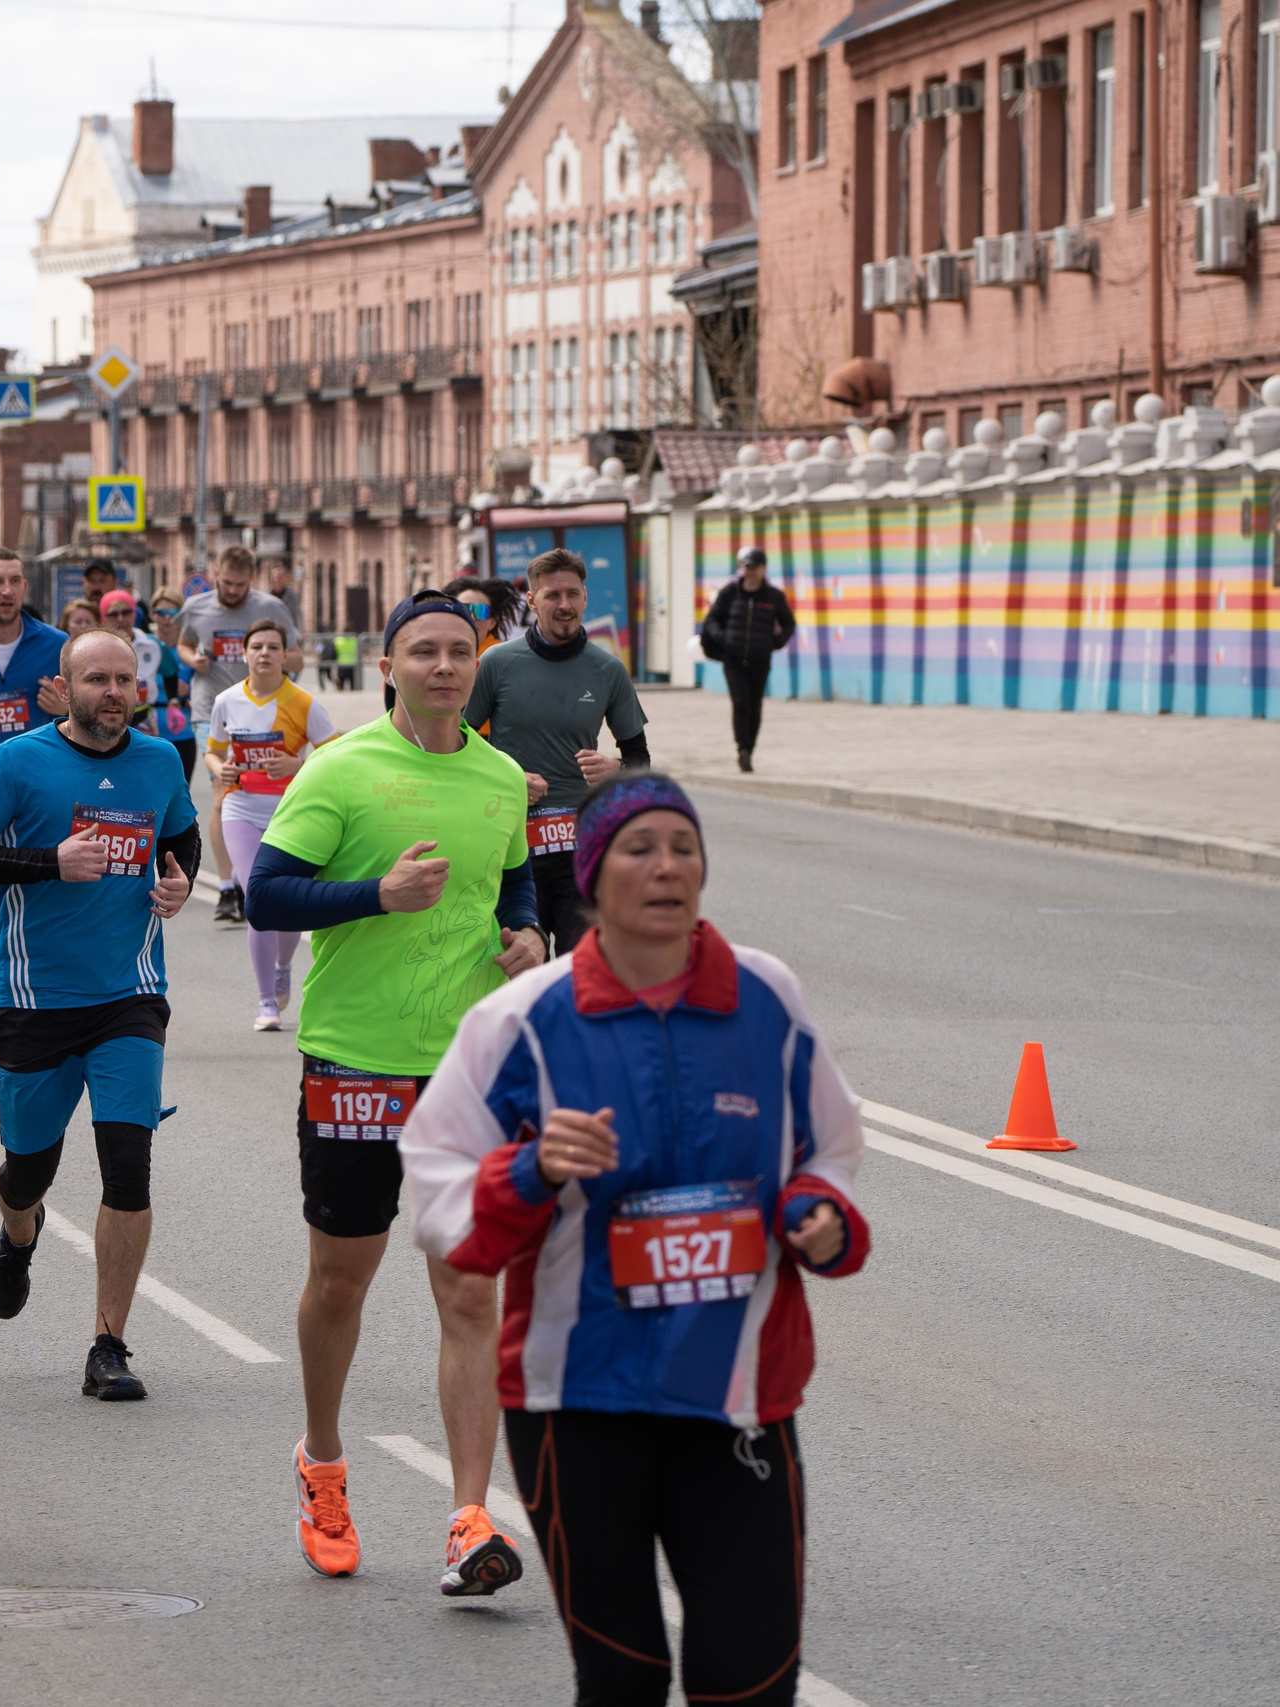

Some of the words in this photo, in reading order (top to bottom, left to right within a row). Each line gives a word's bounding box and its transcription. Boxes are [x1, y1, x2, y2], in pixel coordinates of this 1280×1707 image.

[539, 822, 576, 843] 1092
[338, 1080, 373, 1088] ДМИТРИЙ
[331, 1092, 388, 1122] 1197
[644, 1229, 734, 1281] 1527
